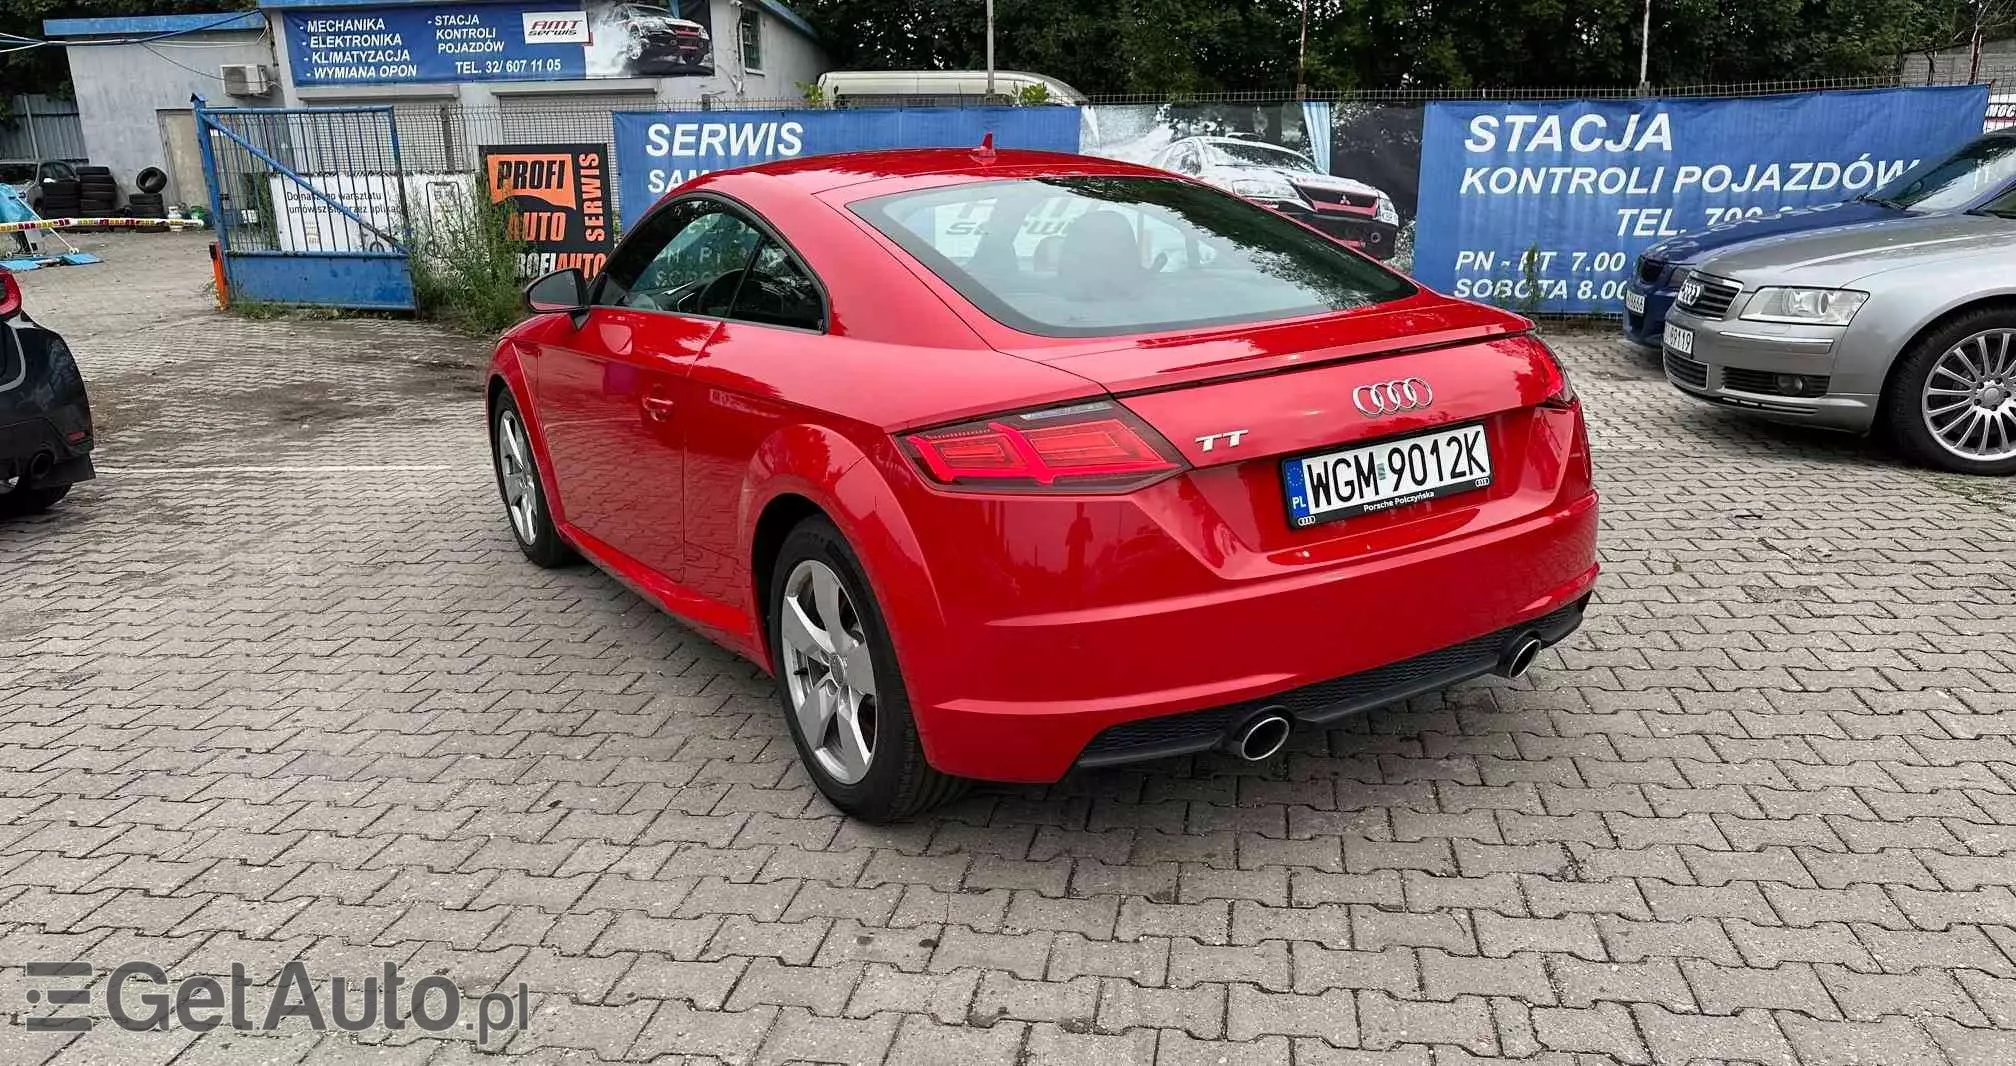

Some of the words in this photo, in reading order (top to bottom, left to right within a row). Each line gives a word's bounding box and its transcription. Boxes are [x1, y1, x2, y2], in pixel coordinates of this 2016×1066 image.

[307, 18, 386, 33] MECHANIKA
[434, 14, 480, 26] STACJA
[530, 19, 583, 30] AMT
[310, 33, 403, 49] ELEKTRONIKA
[435, 28, 496, 41] KONTROLI
[437, 41, 505, 54] POJAZDÓW
[312, 49, 411, 64] KLIMATYZACJA
[314, 66, 376, 80] WYMIANA
[379, 64, 417, 78] OPON
[455, 61, 482, 75] TEL.
[485, 60, 503, 74] 32/
[506, 60, 527, 73] 607
[531, 59, 542, 73] 11
[546, 58, 561, 72] 05
[645, 121, 804, 158] SERWIS
[1464, 112, 1673, 153] STACJA
[497, 160, 566, 190] PROFI
[1459, 166, 1664, 195] KONTROLI
[578, 153, 606, 242] SERWIS
[1616, 207, 1687, 237] TEL.
[1455, 250, 1495, 272] PN
[1570, 251, 1627, 273] 7.00
[1453, 278, 1568, 300] SOBOTA
[1195, 429, 1249, 452] TT
[1306, 451, 1380, 509] WGM
[1387, 430, 1487, 493] 9012K
[1292, 495, 1306, 510] PL
[1363, 499, 1394, 513] Porsche
